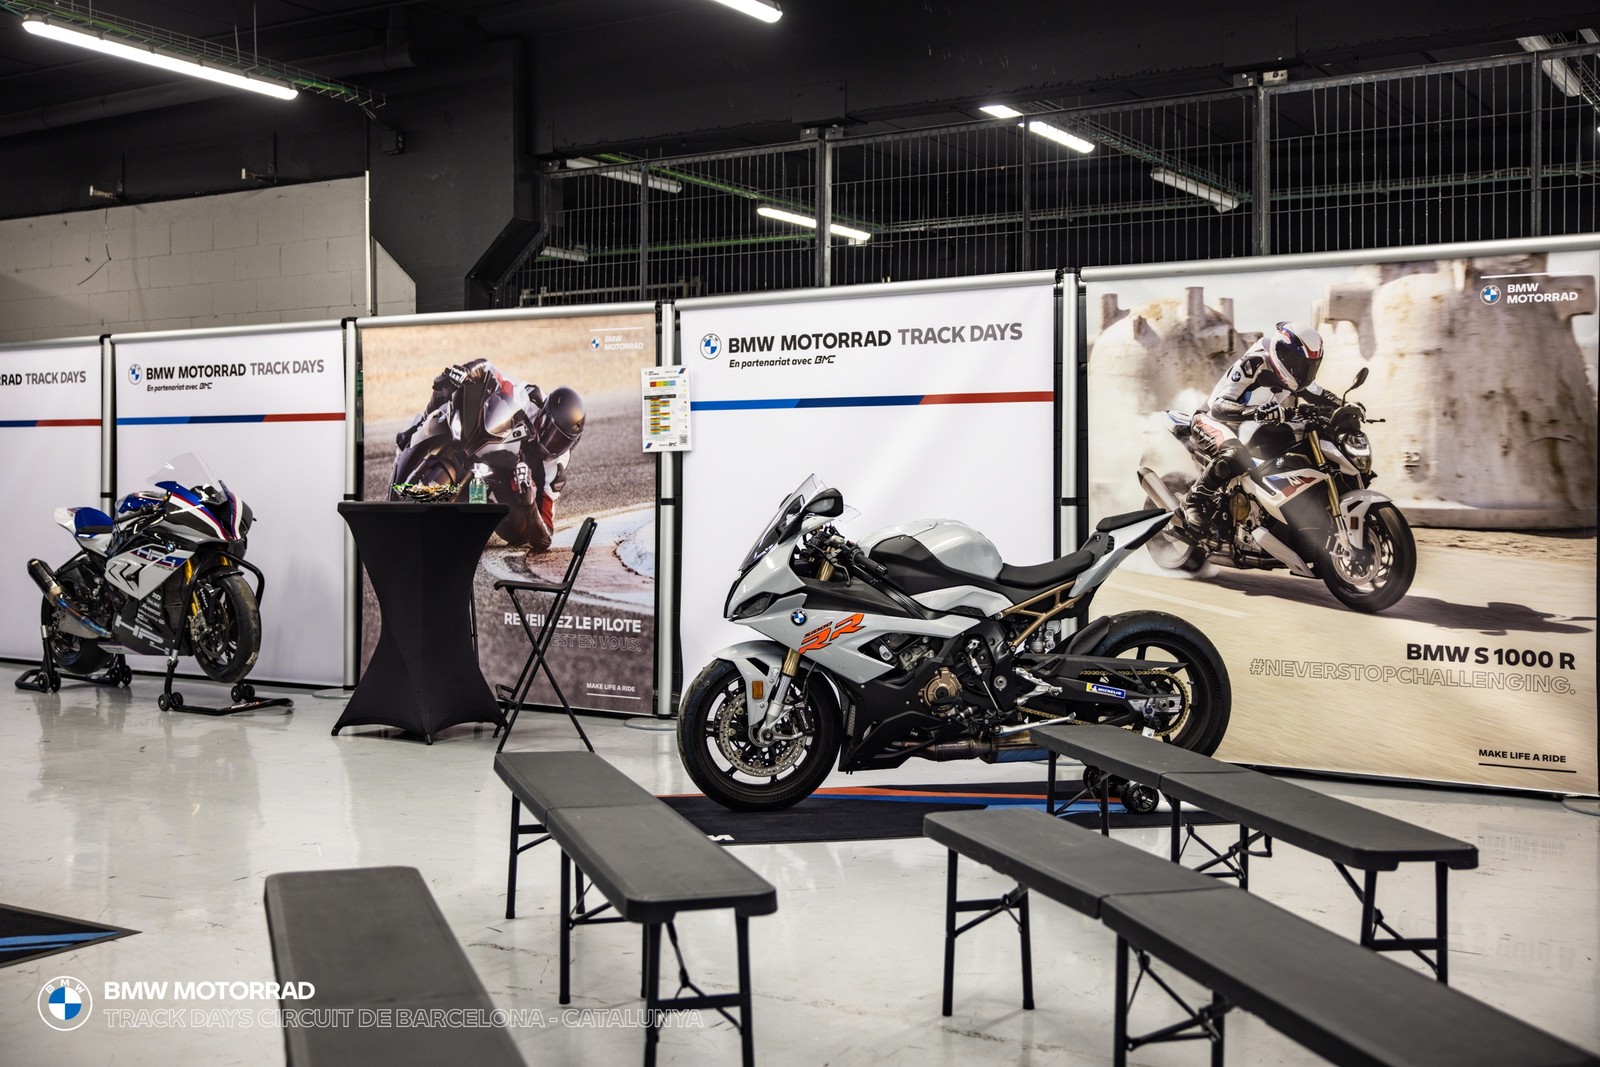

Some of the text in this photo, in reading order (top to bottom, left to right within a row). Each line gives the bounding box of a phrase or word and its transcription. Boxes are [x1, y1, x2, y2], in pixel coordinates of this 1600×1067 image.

[1507, 283, 1539, 293] BMW
[1506, 292, 1579, 304] MOTORRAD
[604, 335, 623, 343] BMW
[728, 323, 1023, 353] BMW MOTORRAD TRACK DAYS
[604, 342, 644, 351] MOTORRAD
[146, 359, 325, 380] BMW MOTORRAD TRACK DAYS
[729, 355, 836, 370] En partenariat avec BMC
[0, 370, 87, 386] RAD TRACK DAYS
[147, 384, 154, 392] En
[154, 381, 185, 393] partenariat
[575, 615, 591, 630] LE
[593, 617, 642, 633] PILOTE
[551, 632, 577, 648] EST
[578, 634, 597, 649] EN
[599, 635, 642, 653] VOUS.
[1406, 643, 1576, 670] BMW S 1000 R
[1249, 658, 1577, 695] #NEVERSTOPCHALLENGING.
[586, 682, 603, 690] MAKE
[1478, 749, 1508, 759] MAKE
[1510, 751, 1531, 761] LIFE
[1542, 754, 1567, 763] RIDE
